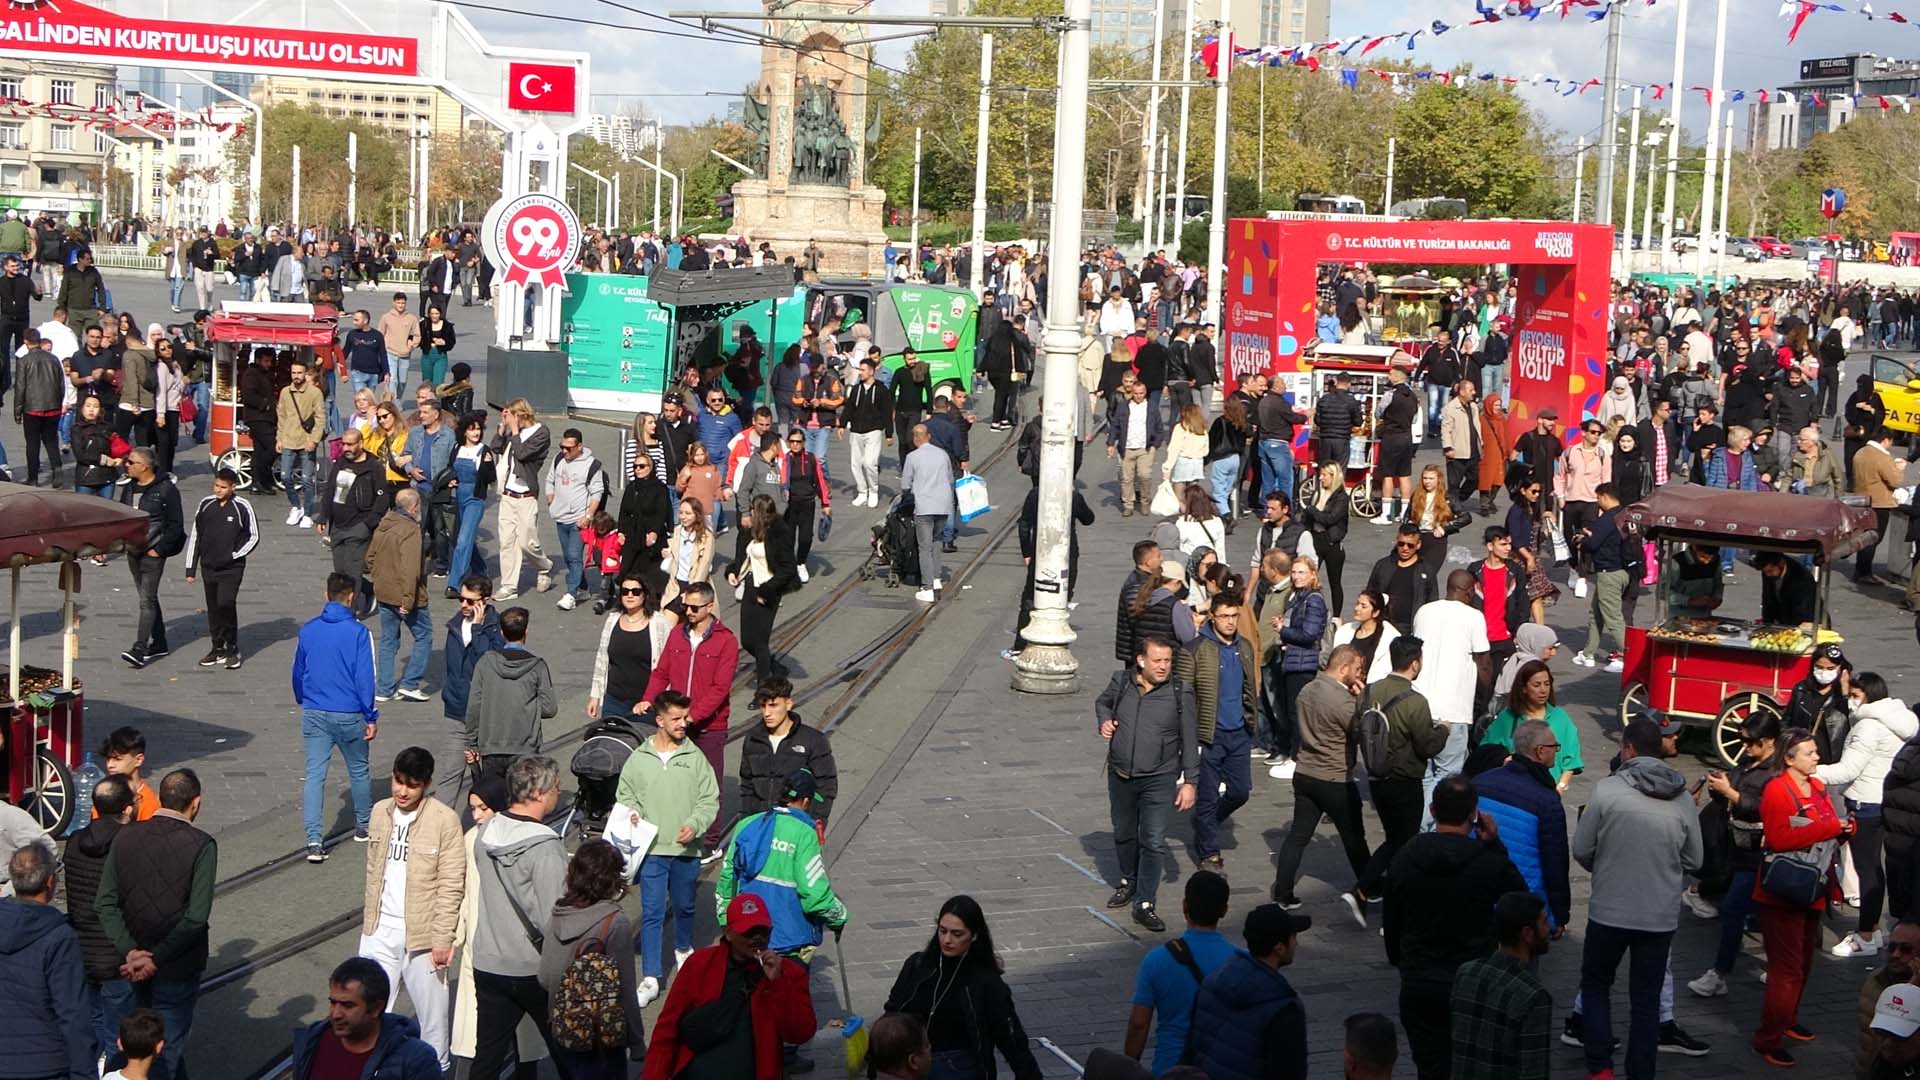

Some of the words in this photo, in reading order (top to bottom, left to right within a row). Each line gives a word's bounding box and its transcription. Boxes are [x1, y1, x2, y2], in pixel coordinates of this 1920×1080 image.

[116, 28, 250, 59] KURTULUŞU
[253, 38, 326, 62] KUTLU
[328, 43, 405, 67] OLSUN
[1821, 193, 1836, 211] M
[1344, 237, 1362, 248] T.C.
[1363, 236, 1402, 249] KÜLTÜR
[1402, 239, 1416, 249] VE
[1417, 238, 1456, 250] TURİZM
[1457, 238, 1511, 250] BAKANLIĞI
[1546, 247, 1573, 257] YOLU
[1231, 344, 1271, 369] KÜLTÜR
[1519, 343, 1565, 367] KÜLTÜR
[1520, 359, 1552, 382] YOLU
